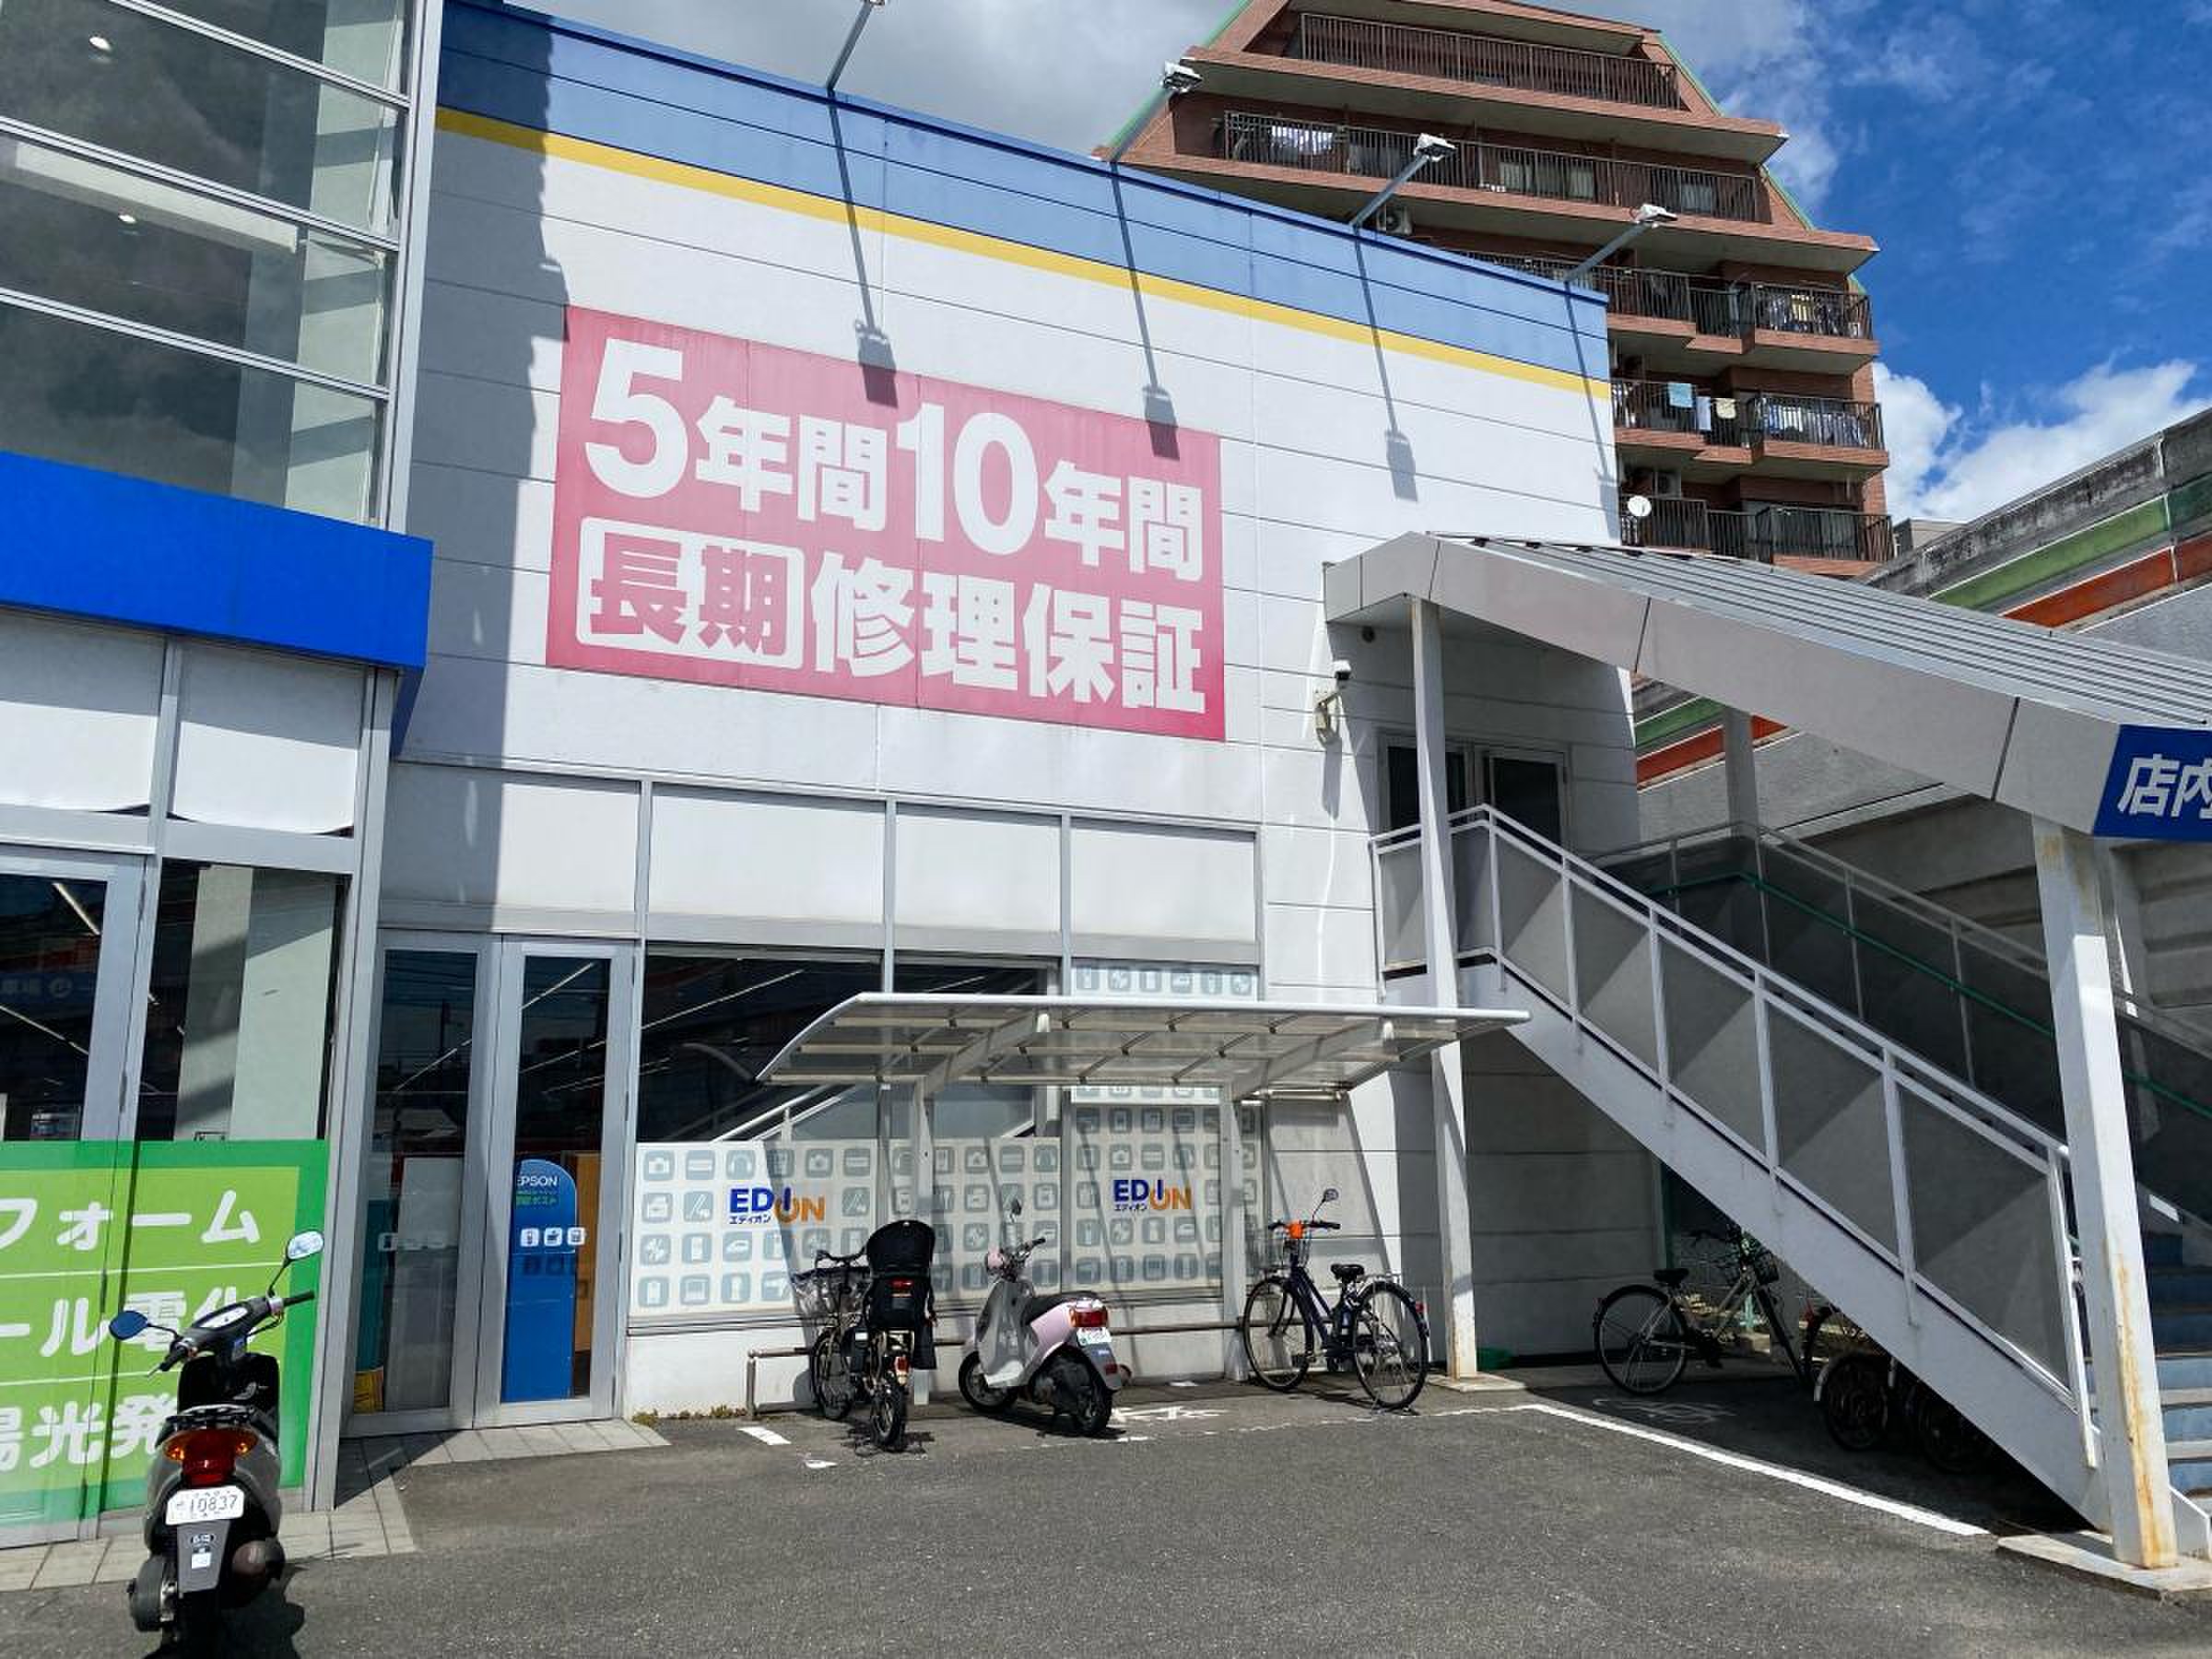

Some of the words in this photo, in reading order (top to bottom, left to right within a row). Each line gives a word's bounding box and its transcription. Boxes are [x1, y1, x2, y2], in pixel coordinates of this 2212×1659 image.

[584, 337, 1202, 582] 5年間10年間
[730, 1186, 825, 1223] EDION
[1112, 1178, 1192, 1211] EDION
